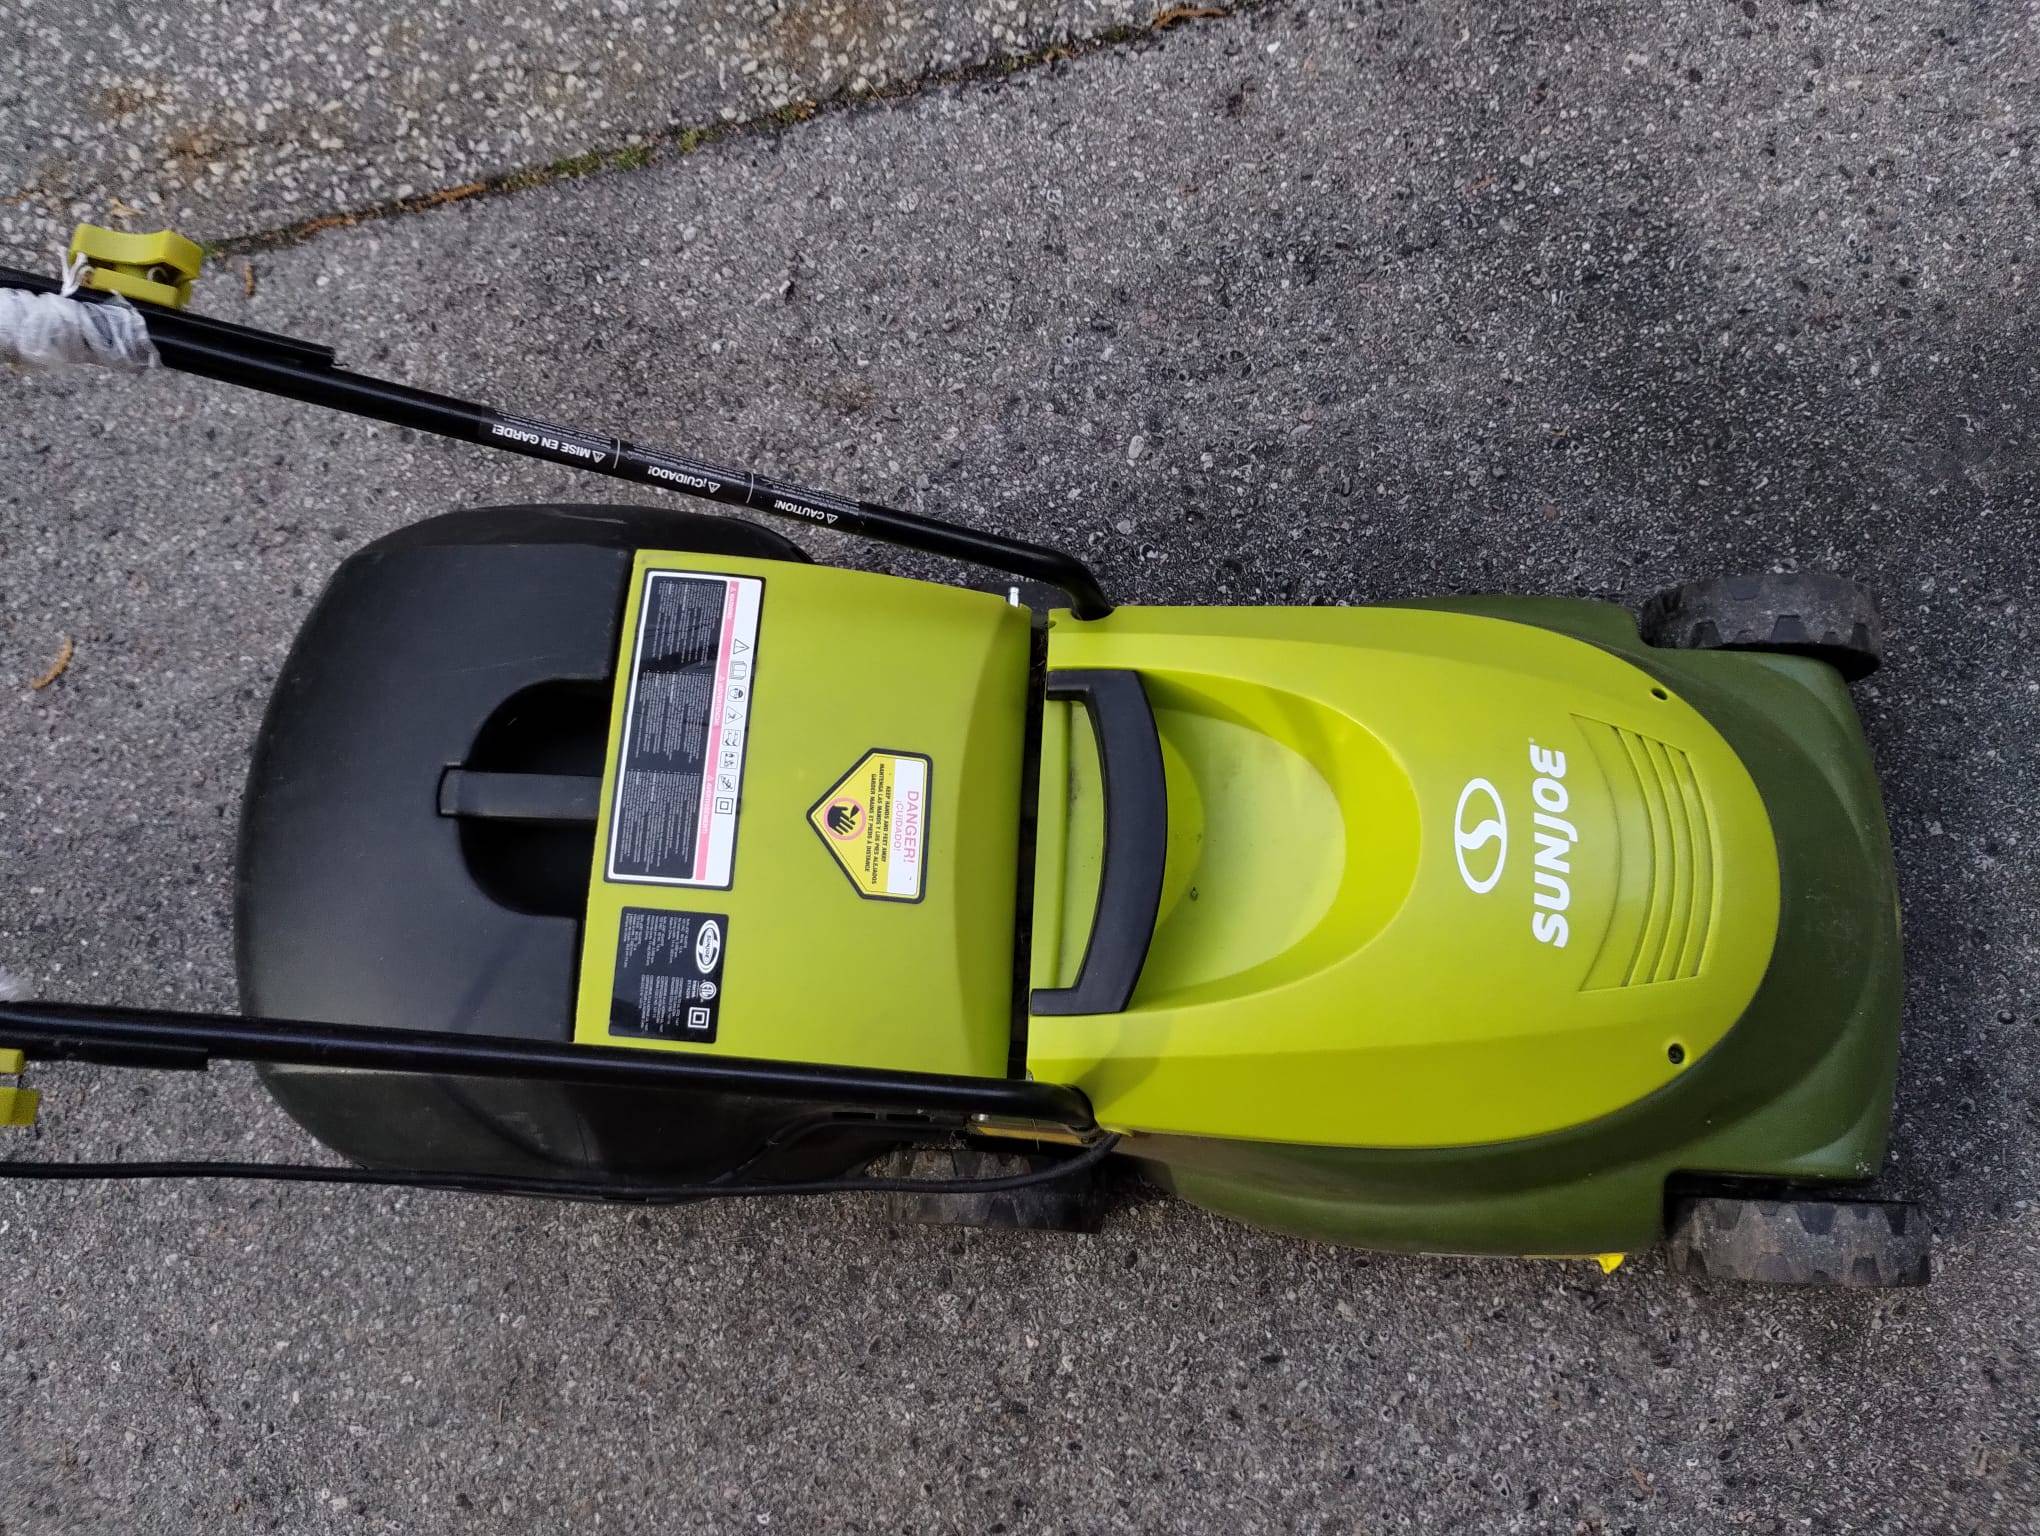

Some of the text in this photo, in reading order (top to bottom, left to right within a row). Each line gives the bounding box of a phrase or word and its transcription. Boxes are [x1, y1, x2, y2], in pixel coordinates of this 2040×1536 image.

[491, 423, 540, 445] GARDE!
[541, 439, 559, 450] EN
[561, 442, 591, 459] MISE
[647, 465, 707, 489] ¡CUIDADO!
[774, 499, 825, 520] CAUTION!
[904, 790, 919, 863] DANGER!
[1529, 743, 1579, 949] SUNJOE
